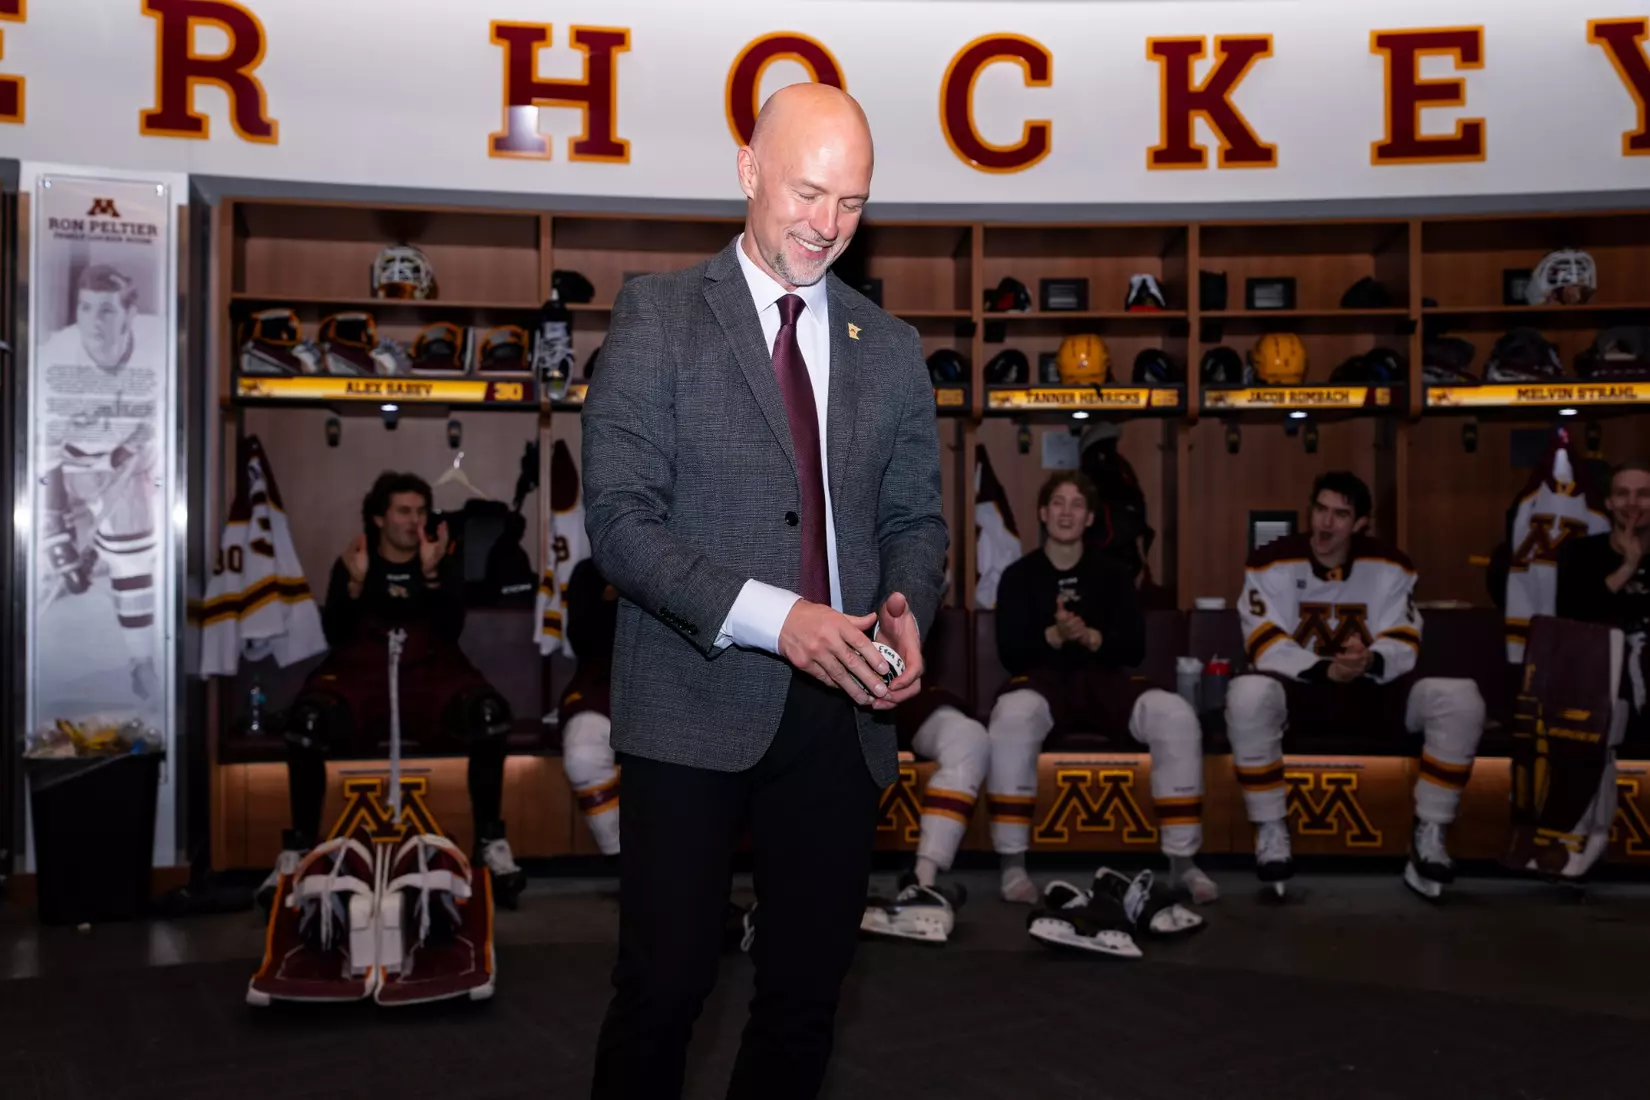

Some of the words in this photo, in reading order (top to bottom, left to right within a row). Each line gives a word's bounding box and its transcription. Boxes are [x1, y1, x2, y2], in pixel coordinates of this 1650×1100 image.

[0, 0, 278, 145] R
[48, 217, 83, 231] RON
[90, 220, 158, 236] PELTIER
[345, 381, 382, 394] ALEX
[1026, 391, 1076, 404] TANNER
[1249, 389, 1285, 403] JACOB
[1517, 387, 1573, 400] MELVIN
[1248, 589, 1267, 618] 5
[327, 777, 445, 844] M
[1034, 769, 1158, 843] M
[1284, 772, 1382, 847] M
